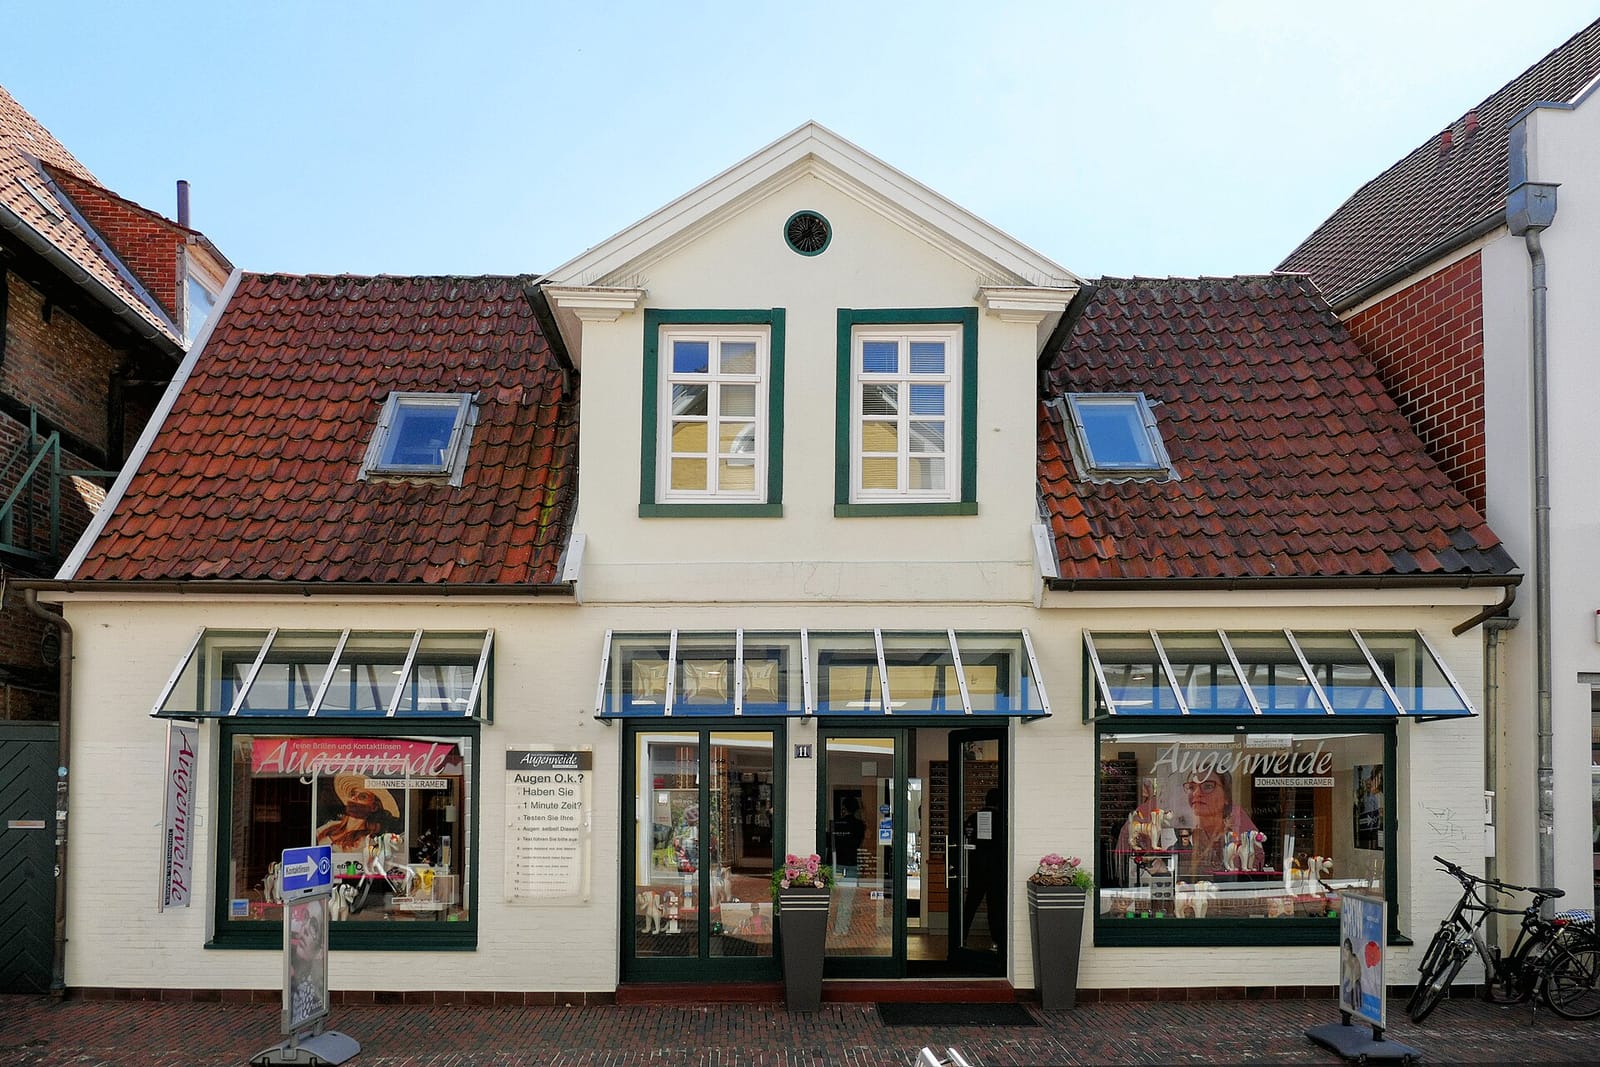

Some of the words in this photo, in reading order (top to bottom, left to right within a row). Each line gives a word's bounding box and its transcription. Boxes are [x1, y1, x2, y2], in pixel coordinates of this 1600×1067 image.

[293, 742, 311, 750] feine
[313, 742, 337, 750] Brillen
[799, 746, 807, 757] 11
[256, 740, 447, 785] Augenweide
[519, 752, 578, 767] Augenweide
[1150, 741, 1333, 784] Augenweide
[366, 780, 405, 788] JOHANNES
[416, 780, 445, 788] KRAMER
[514, 773, 551, 785] Augen
[554, 773, 584, 784] O.k.?
[522, 787, 555, 796] Haben
[558, 787, 574, 796] Sie
[530, 801, 559, 810] Minute
[561, 801, 582, 810] Zeit?
[172, 729, 194, 902] Augenweide
